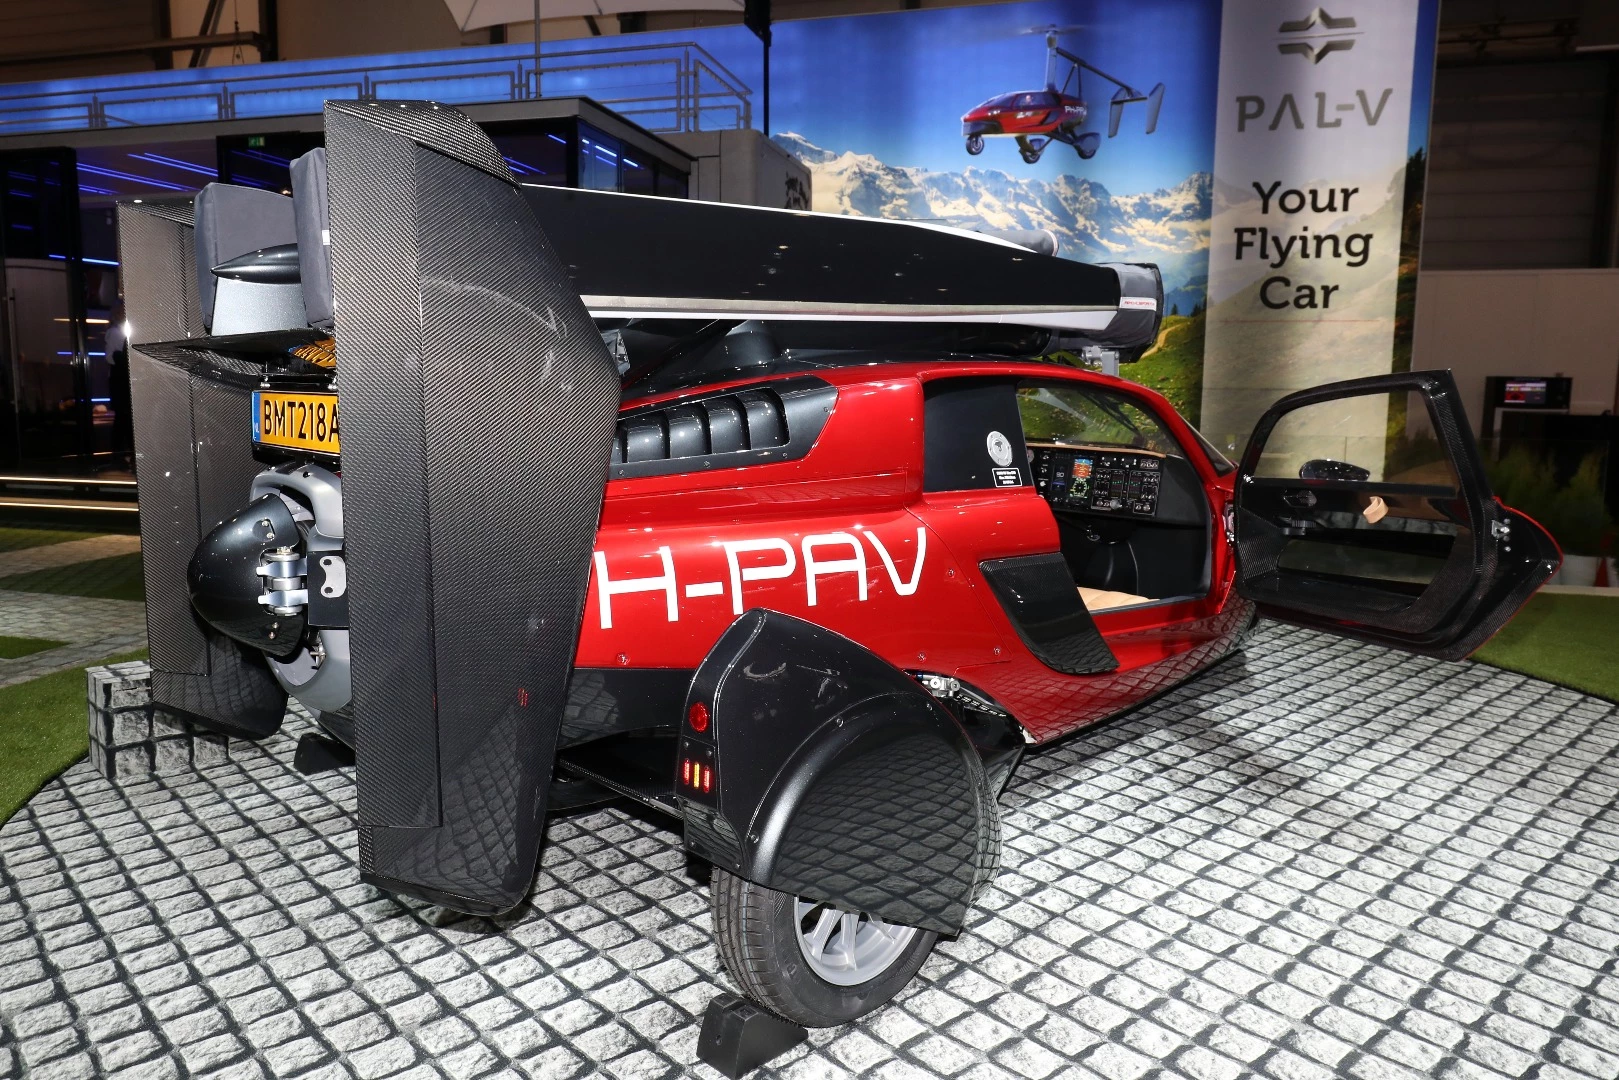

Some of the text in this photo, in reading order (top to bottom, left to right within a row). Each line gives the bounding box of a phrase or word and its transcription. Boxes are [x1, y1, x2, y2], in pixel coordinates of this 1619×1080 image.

[1235, 88, 1393, 132] PAL-V
[1252, 181, 1359, 215] Your
[1234, 226, 1373, 268] Flying
[1259, 276, 1339, 309] Car
[264, 400, 340, 442] BMT218A
[594, 527, 926, 630] H-PAV
